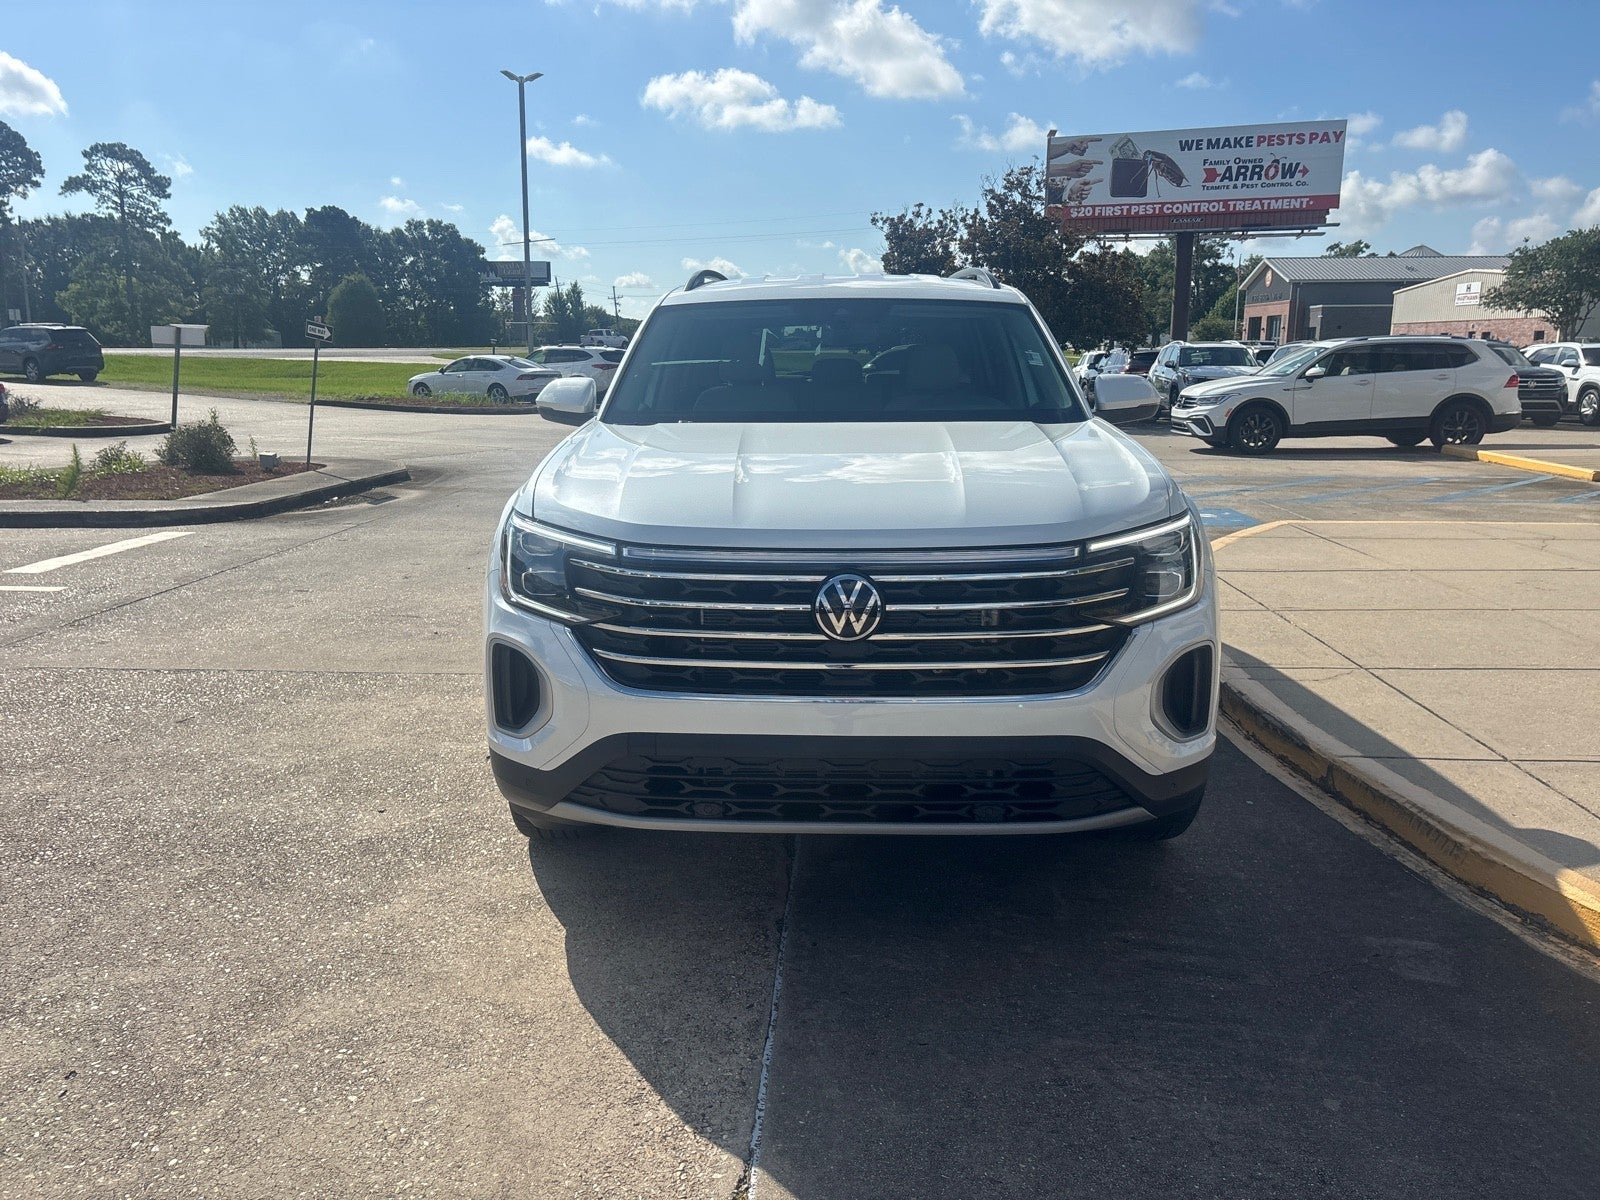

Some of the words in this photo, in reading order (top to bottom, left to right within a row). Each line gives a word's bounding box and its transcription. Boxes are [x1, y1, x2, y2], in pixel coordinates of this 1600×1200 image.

[1178, 138, 1204, 152] WE
[1206, 135, 1255, 150] MAKE
[1256, 132, 1306, 148] PESTS
[1308, 130, 1345, 145] PAY
[1219, 161, 1301, 183] ARROW
[1070, 206, 1093, 219] $20
[1094, 205, 1130, 218] FIRST
[1131, 204, 1162, 216] PEST
[1163, 201, 1226, 214] CONTROL
